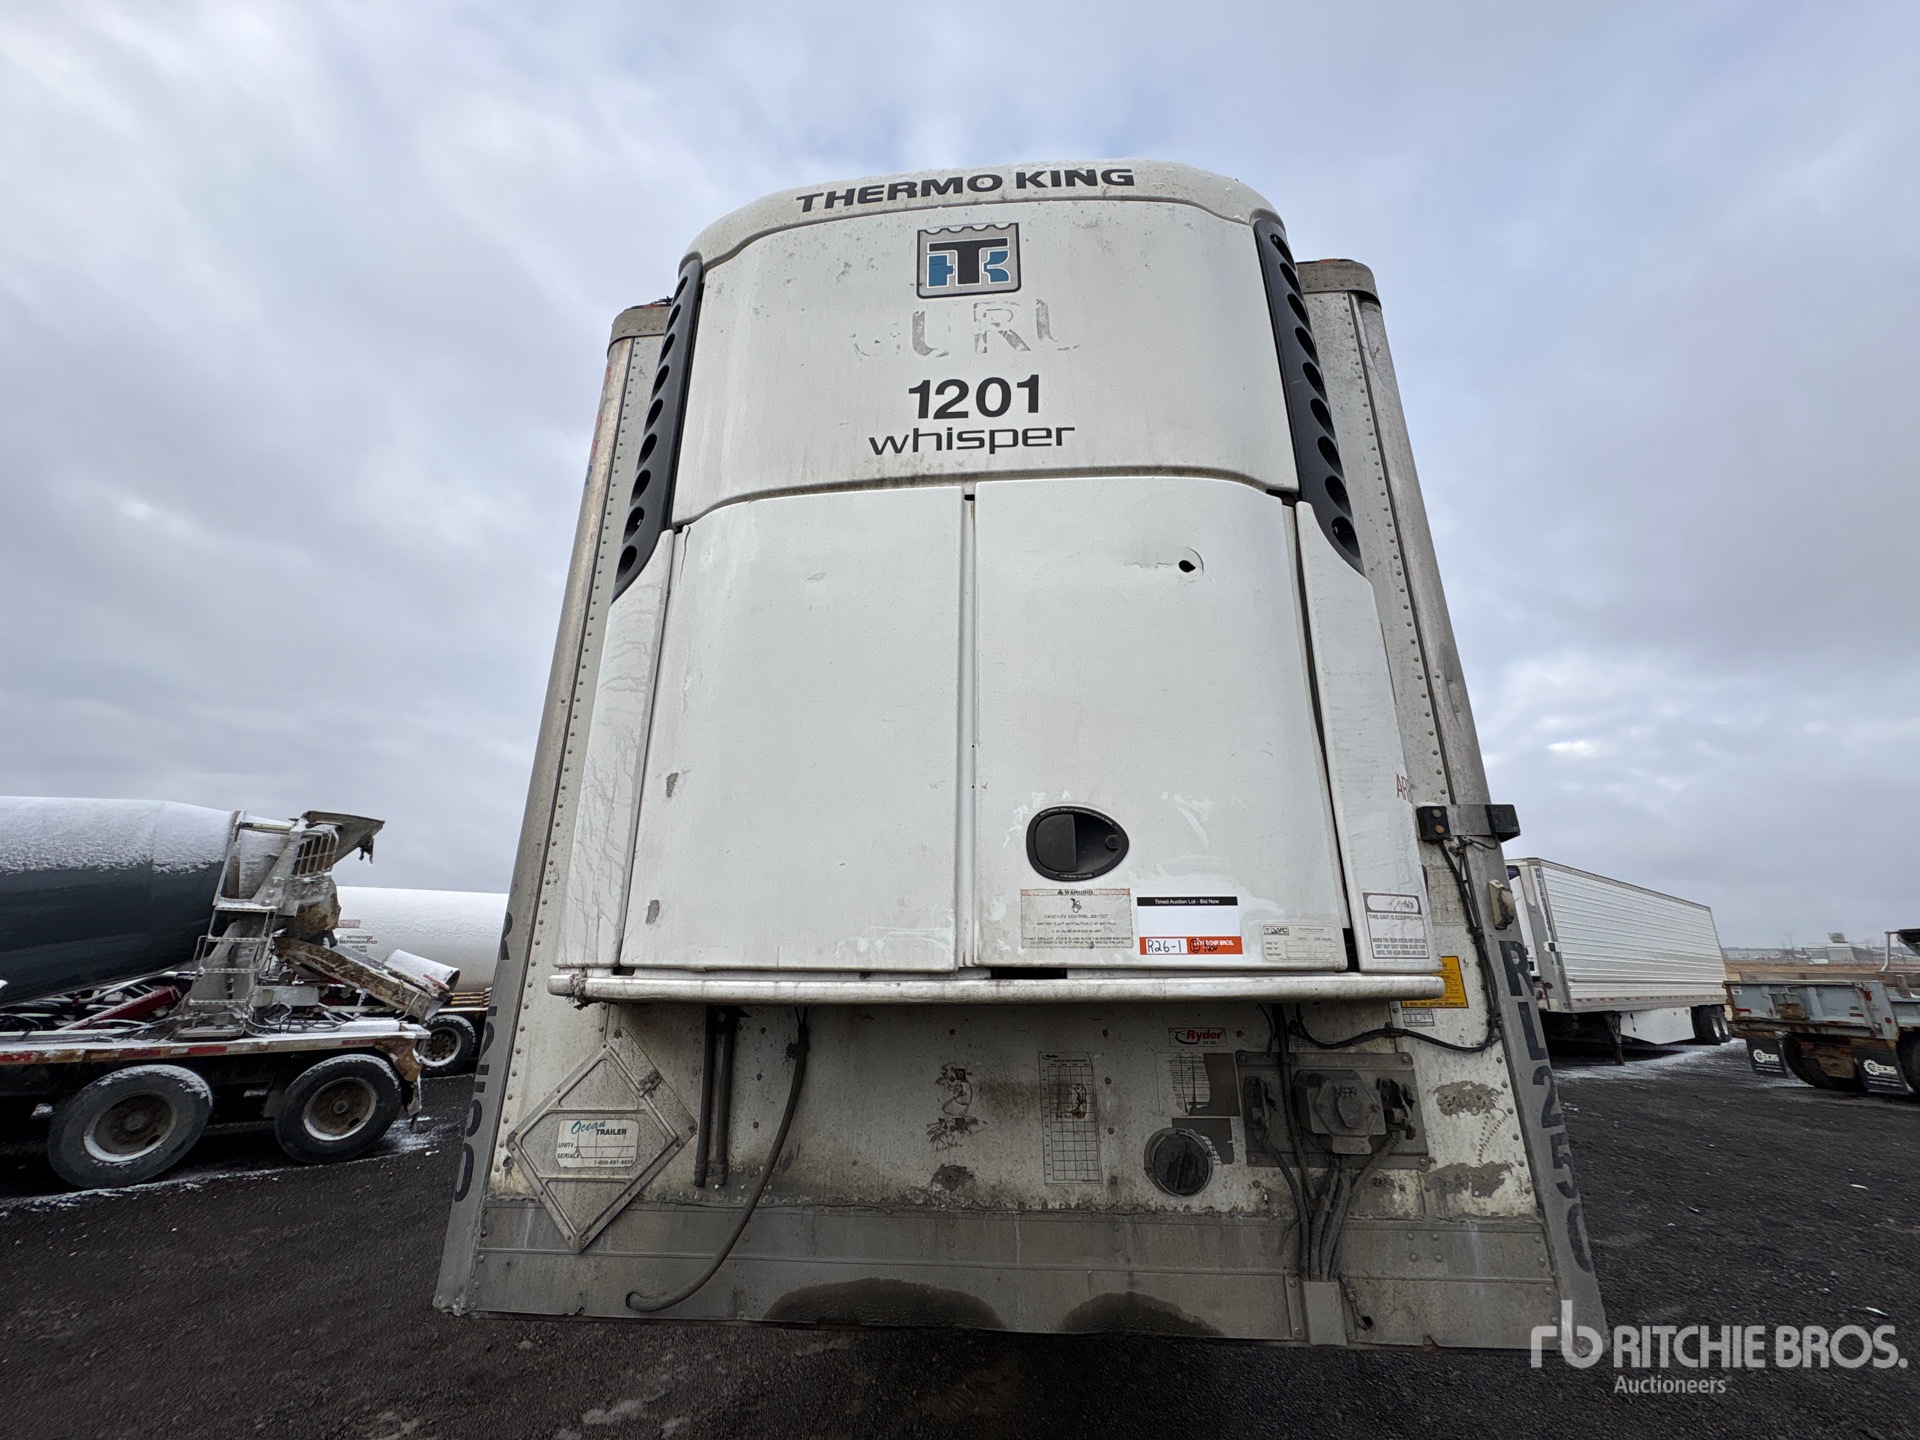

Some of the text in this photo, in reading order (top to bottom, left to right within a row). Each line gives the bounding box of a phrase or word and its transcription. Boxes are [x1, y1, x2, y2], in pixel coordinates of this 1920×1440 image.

[795, 168, 1136, 213] THERMO KING
[908, 374, 1040, 420] 1201
[868, 427, 1076, 456] whisper
[1186, 1029, 1223, 1042] Ryder
[570, 1120, 607, 1135] Ocean
[595, 1128, 627, 1136] TRAILER
